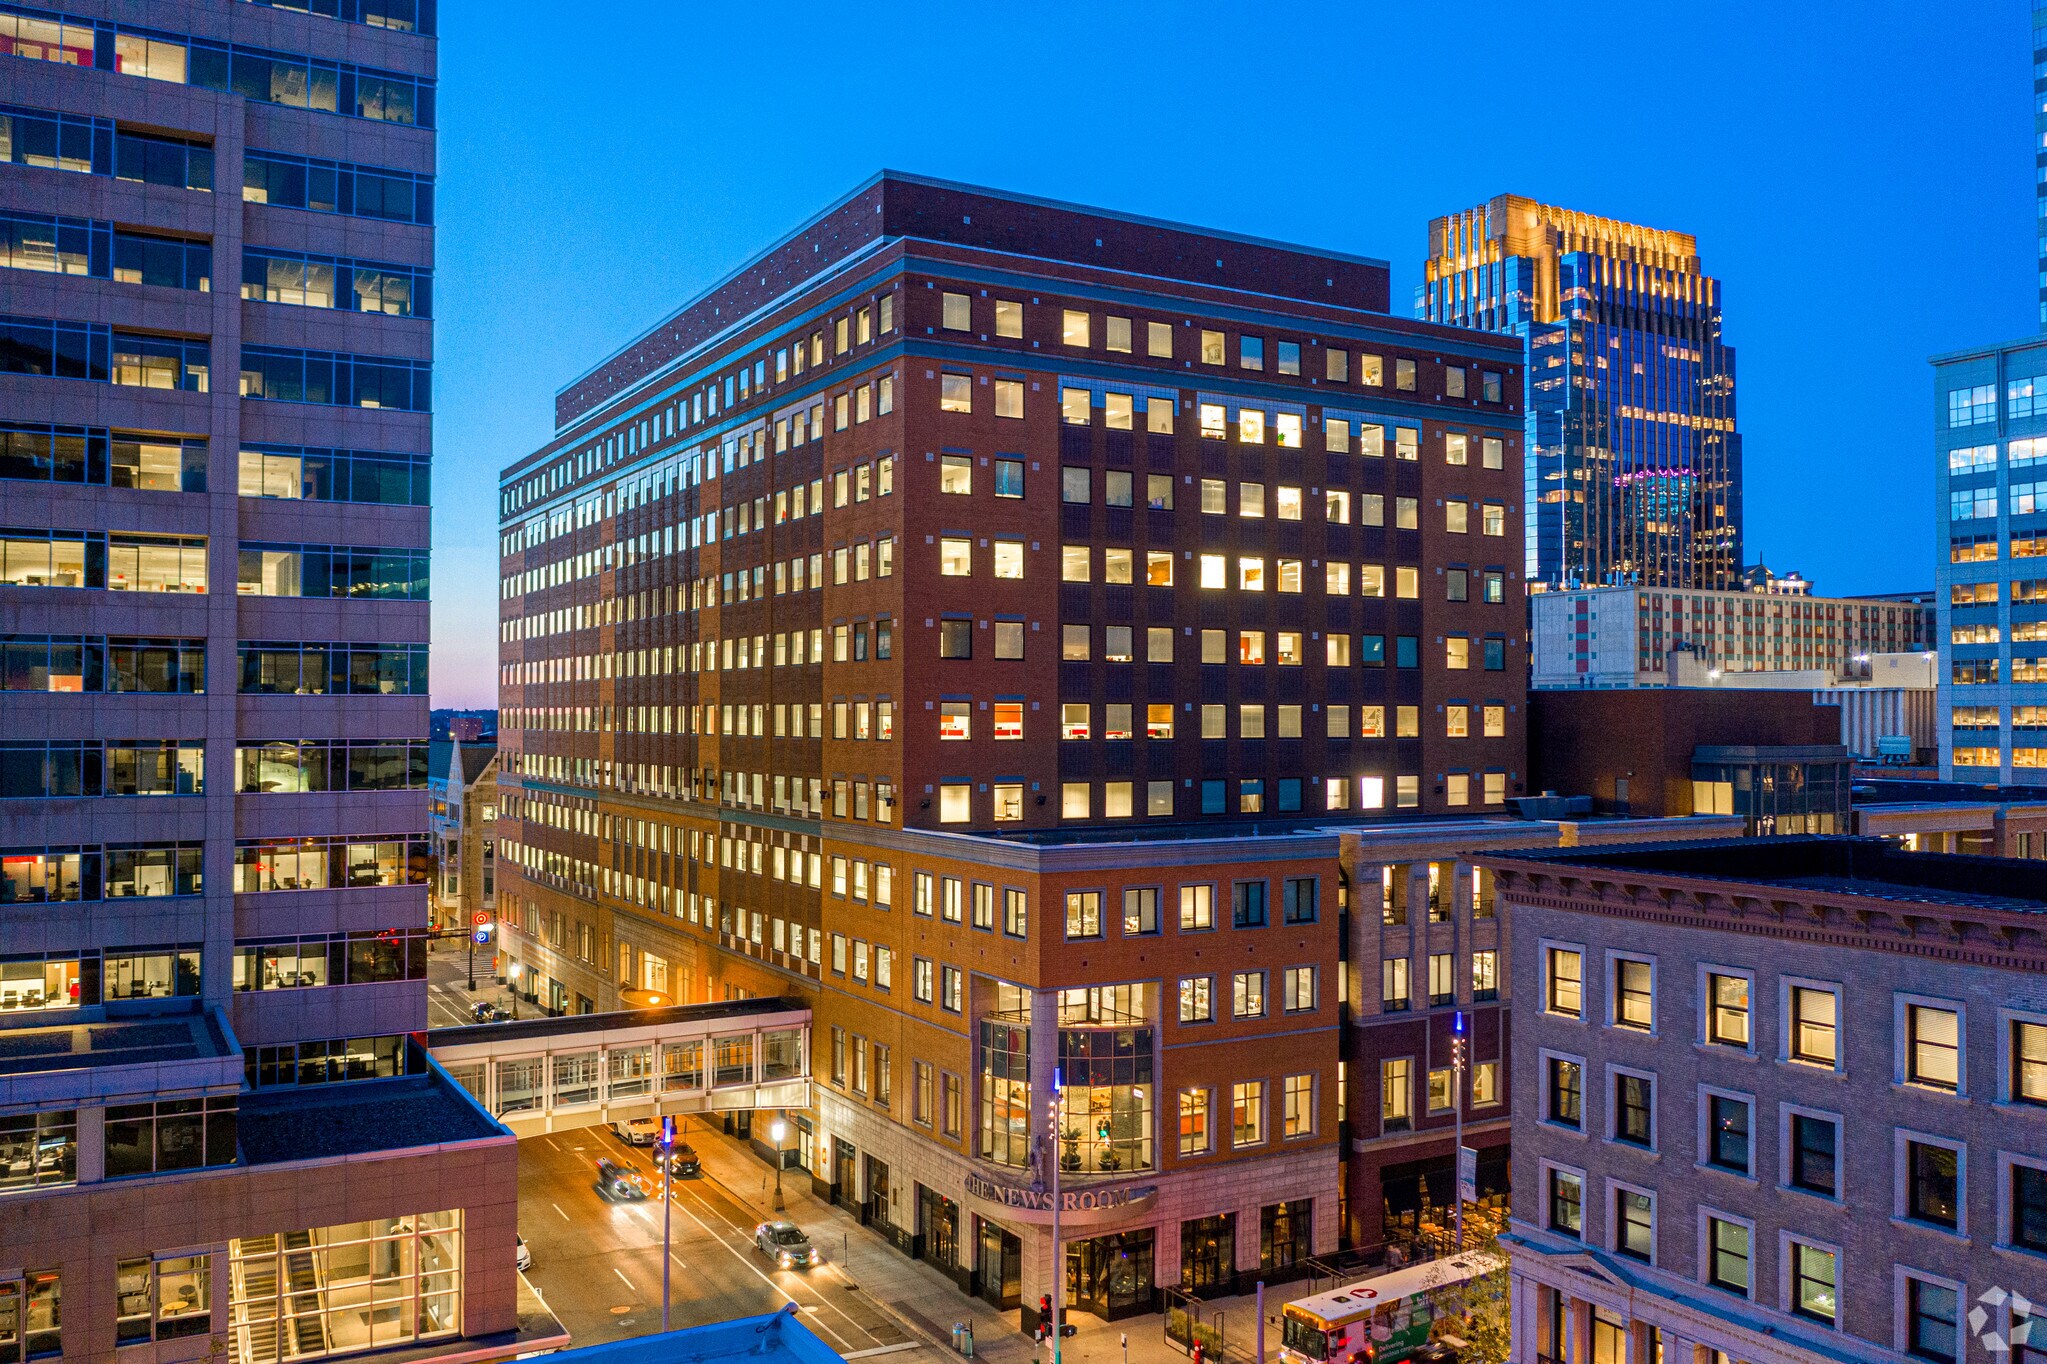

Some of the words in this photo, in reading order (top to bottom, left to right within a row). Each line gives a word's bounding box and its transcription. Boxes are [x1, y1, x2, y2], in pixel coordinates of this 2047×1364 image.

[966, 1173, 990, 1200] THE
[994, 1185, 1055, 1211] NEWS
[1062, 1187, 1131, 1211] ROOM
